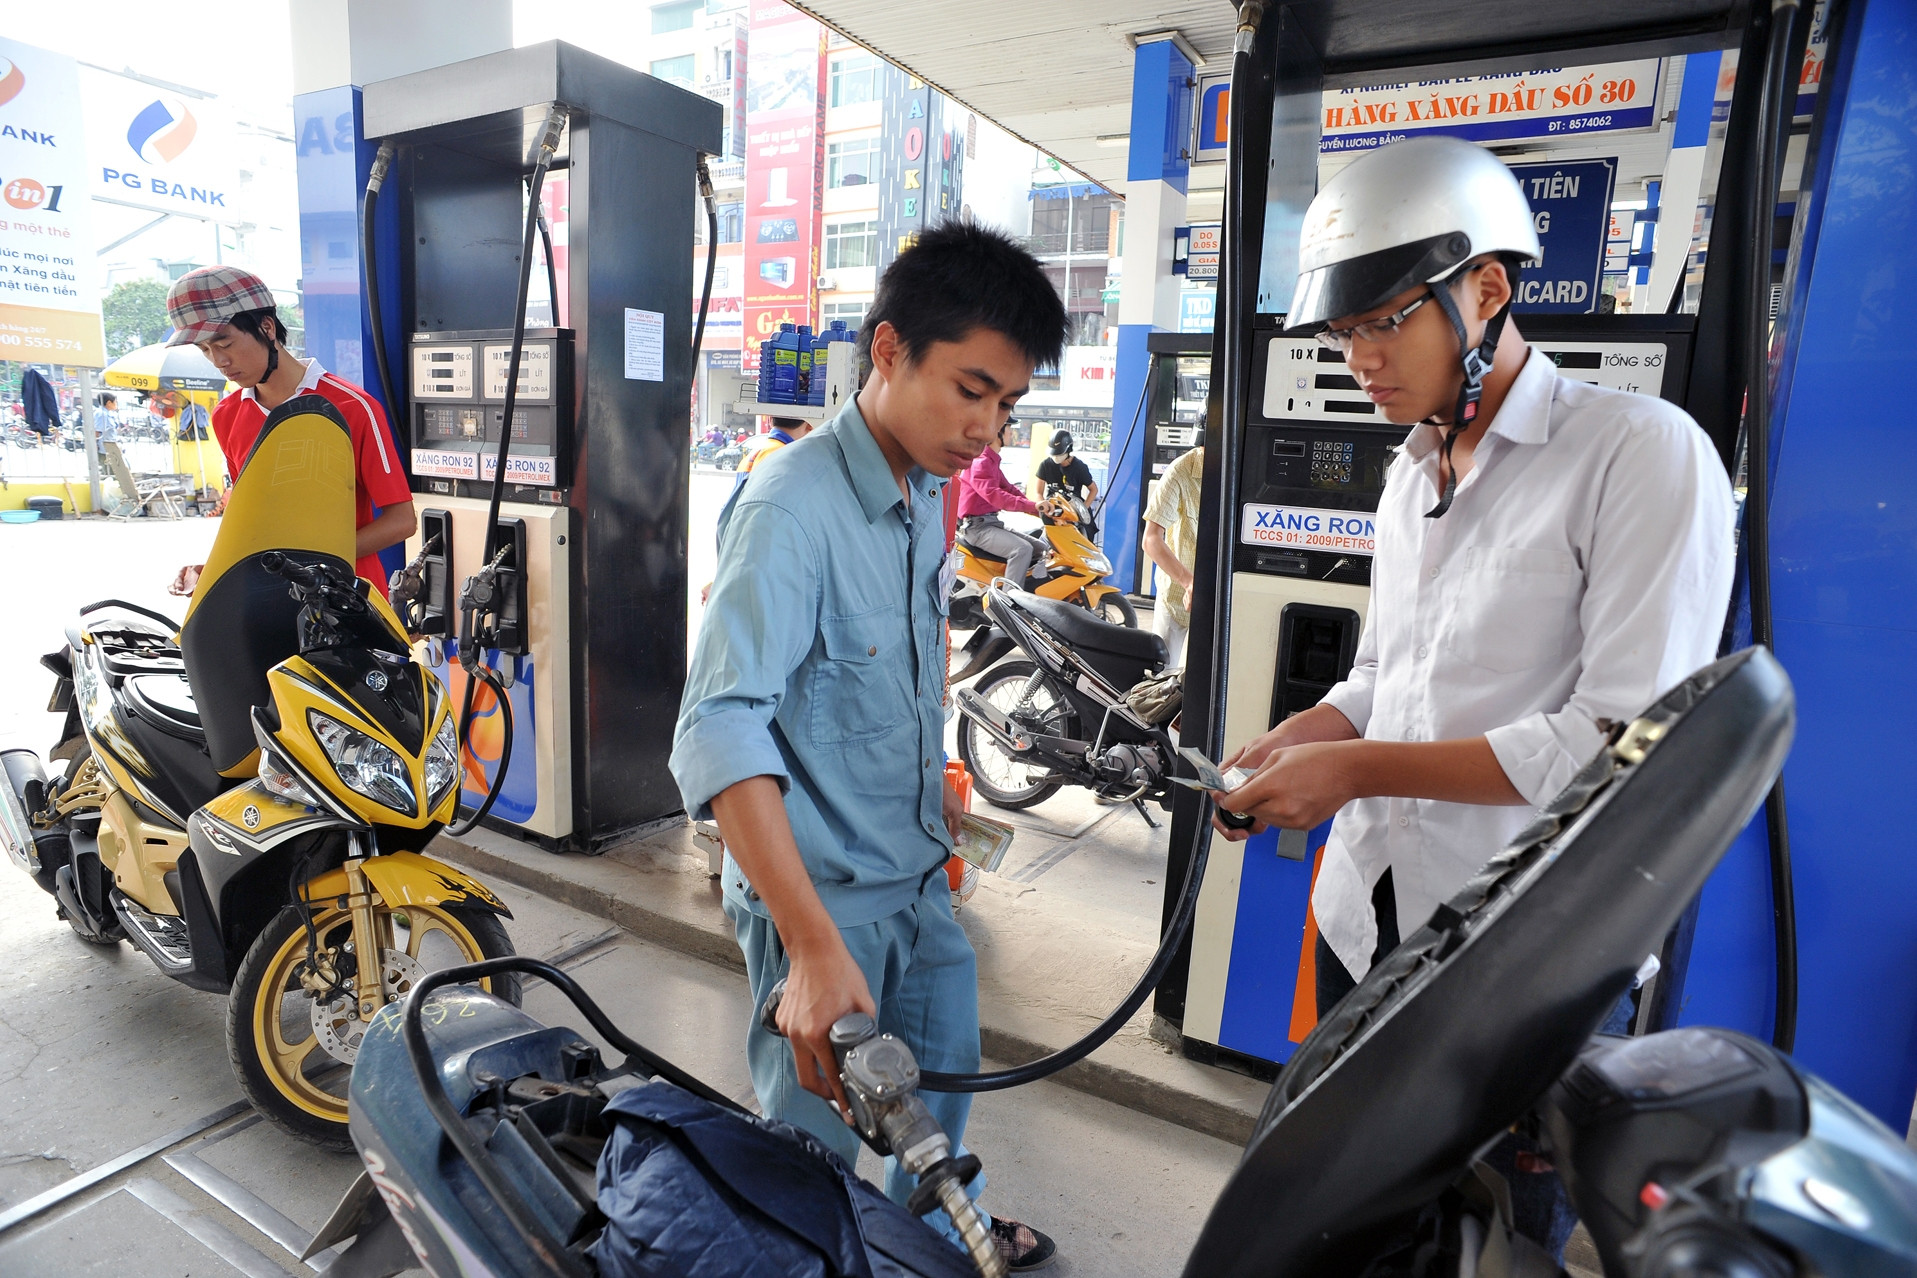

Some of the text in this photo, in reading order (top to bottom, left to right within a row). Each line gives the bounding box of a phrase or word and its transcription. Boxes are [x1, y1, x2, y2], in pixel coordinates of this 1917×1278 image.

[1325, 73, 1636, 129] HÀNG XĂNG DẦU SỐ 30
[1568, 116, 1612, 129] 8574062
[2, 124, 57, 147] ANK
[102, 167, 226, 207] PG BANK
[1531, 171, 1580, 199] TIÊN
[1199, 232, 1213, 240] DO
[1189, 267, 1218, 275] 20.800
[24, 336, 52, 349] 555
[56, 339, 82, 351] 574
[1290, 348, 1314, 360] 10 X
[1604, 353, 1663, 367] TỔNG SỐ
[131, 377, 148, 387] 099
[415, 453, 473, 467] XĂNG RON 92
[485, 456, 550, 473] XĂG RON 92
[1254, 508, 1375, 537] XĂNG RON
[1253, 529, 1283, 542] TCCS
[1286, 532, 1303, 544] 01:
